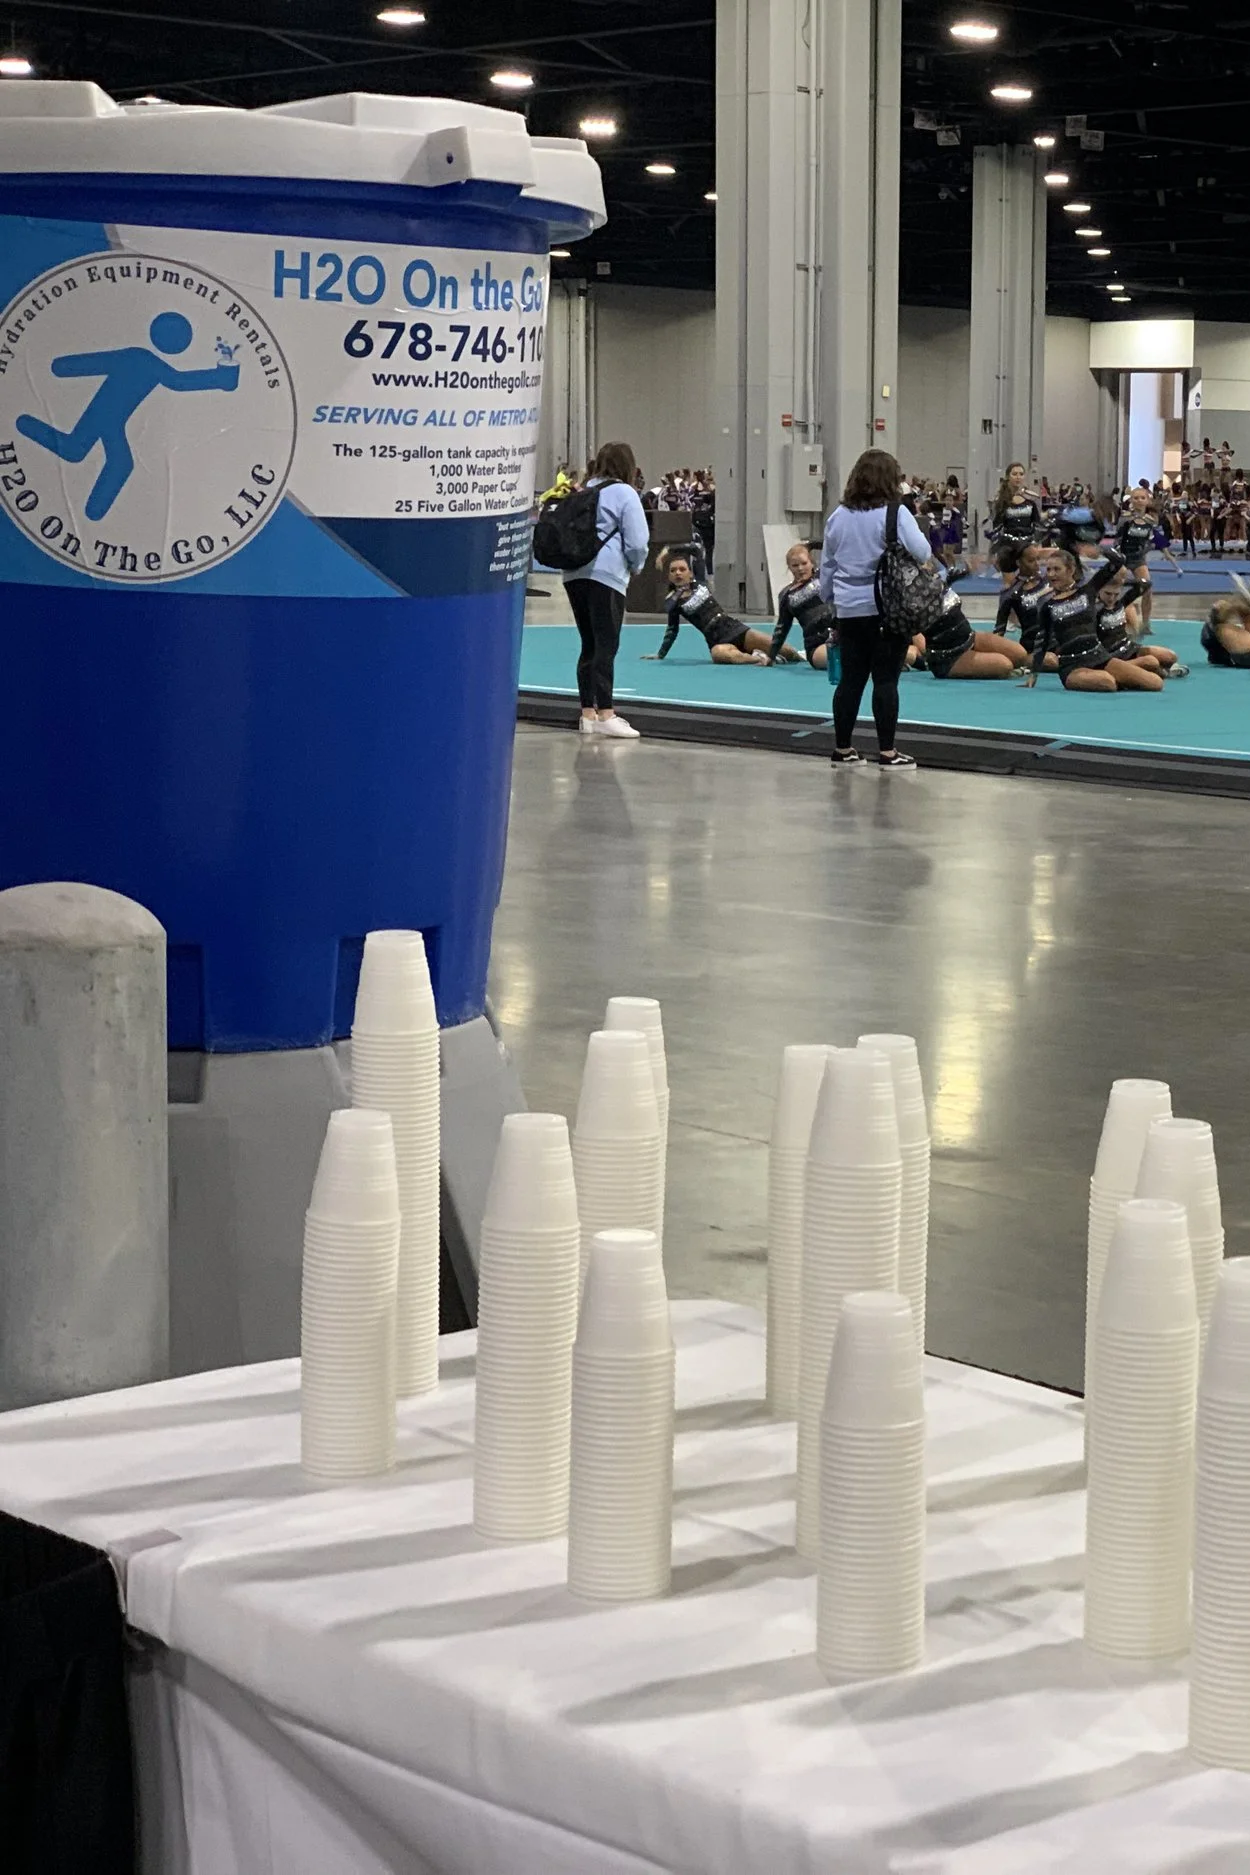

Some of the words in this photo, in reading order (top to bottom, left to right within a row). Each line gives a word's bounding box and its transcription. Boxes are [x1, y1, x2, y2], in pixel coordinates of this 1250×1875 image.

[273, 249, 387, 305] H2O
[402, 259, 459, 310] On
[470, 262, 514, 312] the
[520, 266, 543, 312] Go
[86, 262, 220, 304] Equipment
[224, 302, 281, 389] Rentals
[312, 405, 419, 427] SERVING
[423, 409, 457, 427] ALL
[463, 410, 486, 427] OF
[488, 408, 526, 426] METRO
[332, 443, 363, 458] The
[369, 445, 443, 462] 125-gallon
[447, 446, 472, 459] tank
[474, 445, 510, 461] capacity
[511, 444, 517, 457] is
[429, 464, 463, 478] 1,000
[466, 463, 495, 476] Water
[436, 482, 468, 496] 3,000
[471, 481, 498, 496] Paper
[500, 479, 517, 494] Cups
[0, 441, 39, 513] H2O
[40, 515, 82, 557] On
[94, 540, 162, 572] The
[171, 535, 230, 565] Go,
[224, 464, 276, 529] LLC
[395, 500, 412, 513] 25
[417, 499, 444, 513] Five
[448, 498, 482, 512] Gallon
[484, 498, 508, 510] Water
